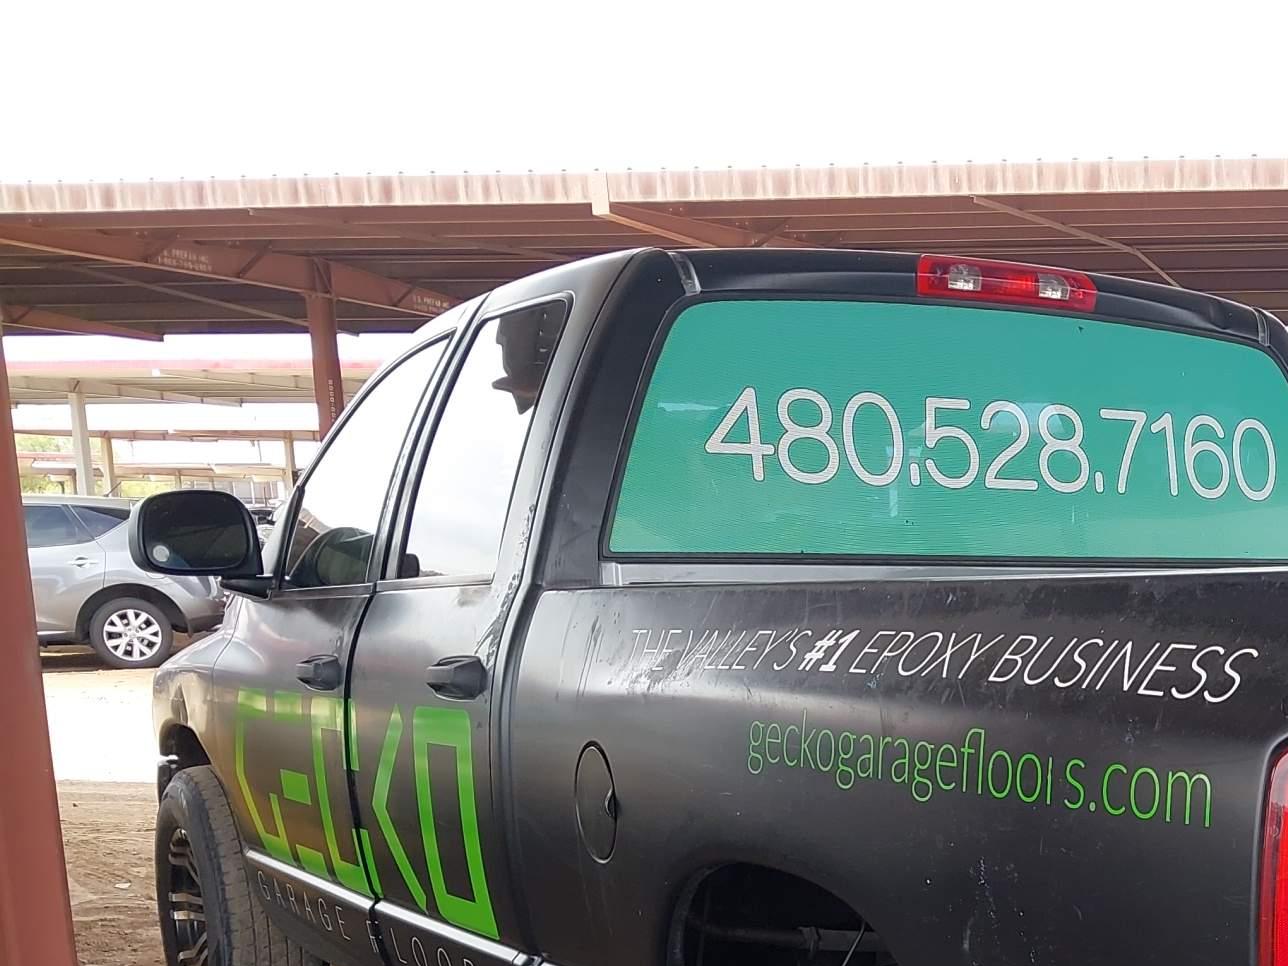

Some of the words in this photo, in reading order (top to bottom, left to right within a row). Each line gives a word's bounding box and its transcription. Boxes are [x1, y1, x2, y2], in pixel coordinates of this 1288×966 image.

[705, 386, 1277, 500] 480.528.7160
[630, 629, 683, 672] THE
[676, 628, 812, 672] VALLEY'S
[798, 629, 860, 672] #1
[849, 630, 1004, 680] EPOXY
[988, 634, 1259, 703] BUSINESS
[256, 870, 352, 941] GARAGE
